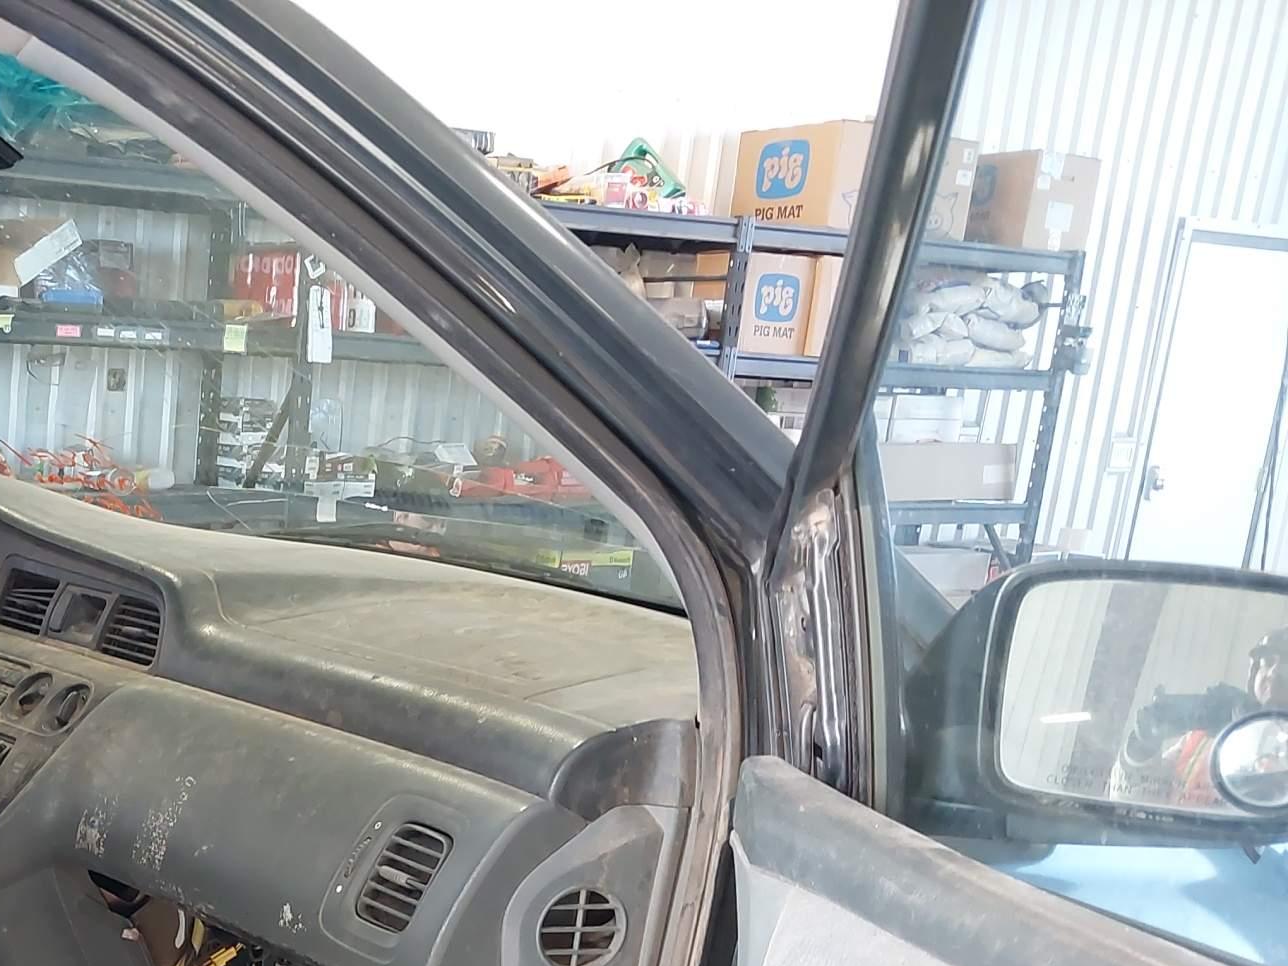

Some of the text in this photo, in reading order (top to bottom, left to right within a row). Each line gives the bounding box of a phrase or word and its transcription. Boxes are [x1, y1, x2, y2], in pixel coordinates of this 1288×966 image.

[762, 145, 804, 192] pig
[755, 205, 803, 220] PIG MAT
[760, 280, 795, 316] pig
[753, 325, 795, 339] PIG MAT
